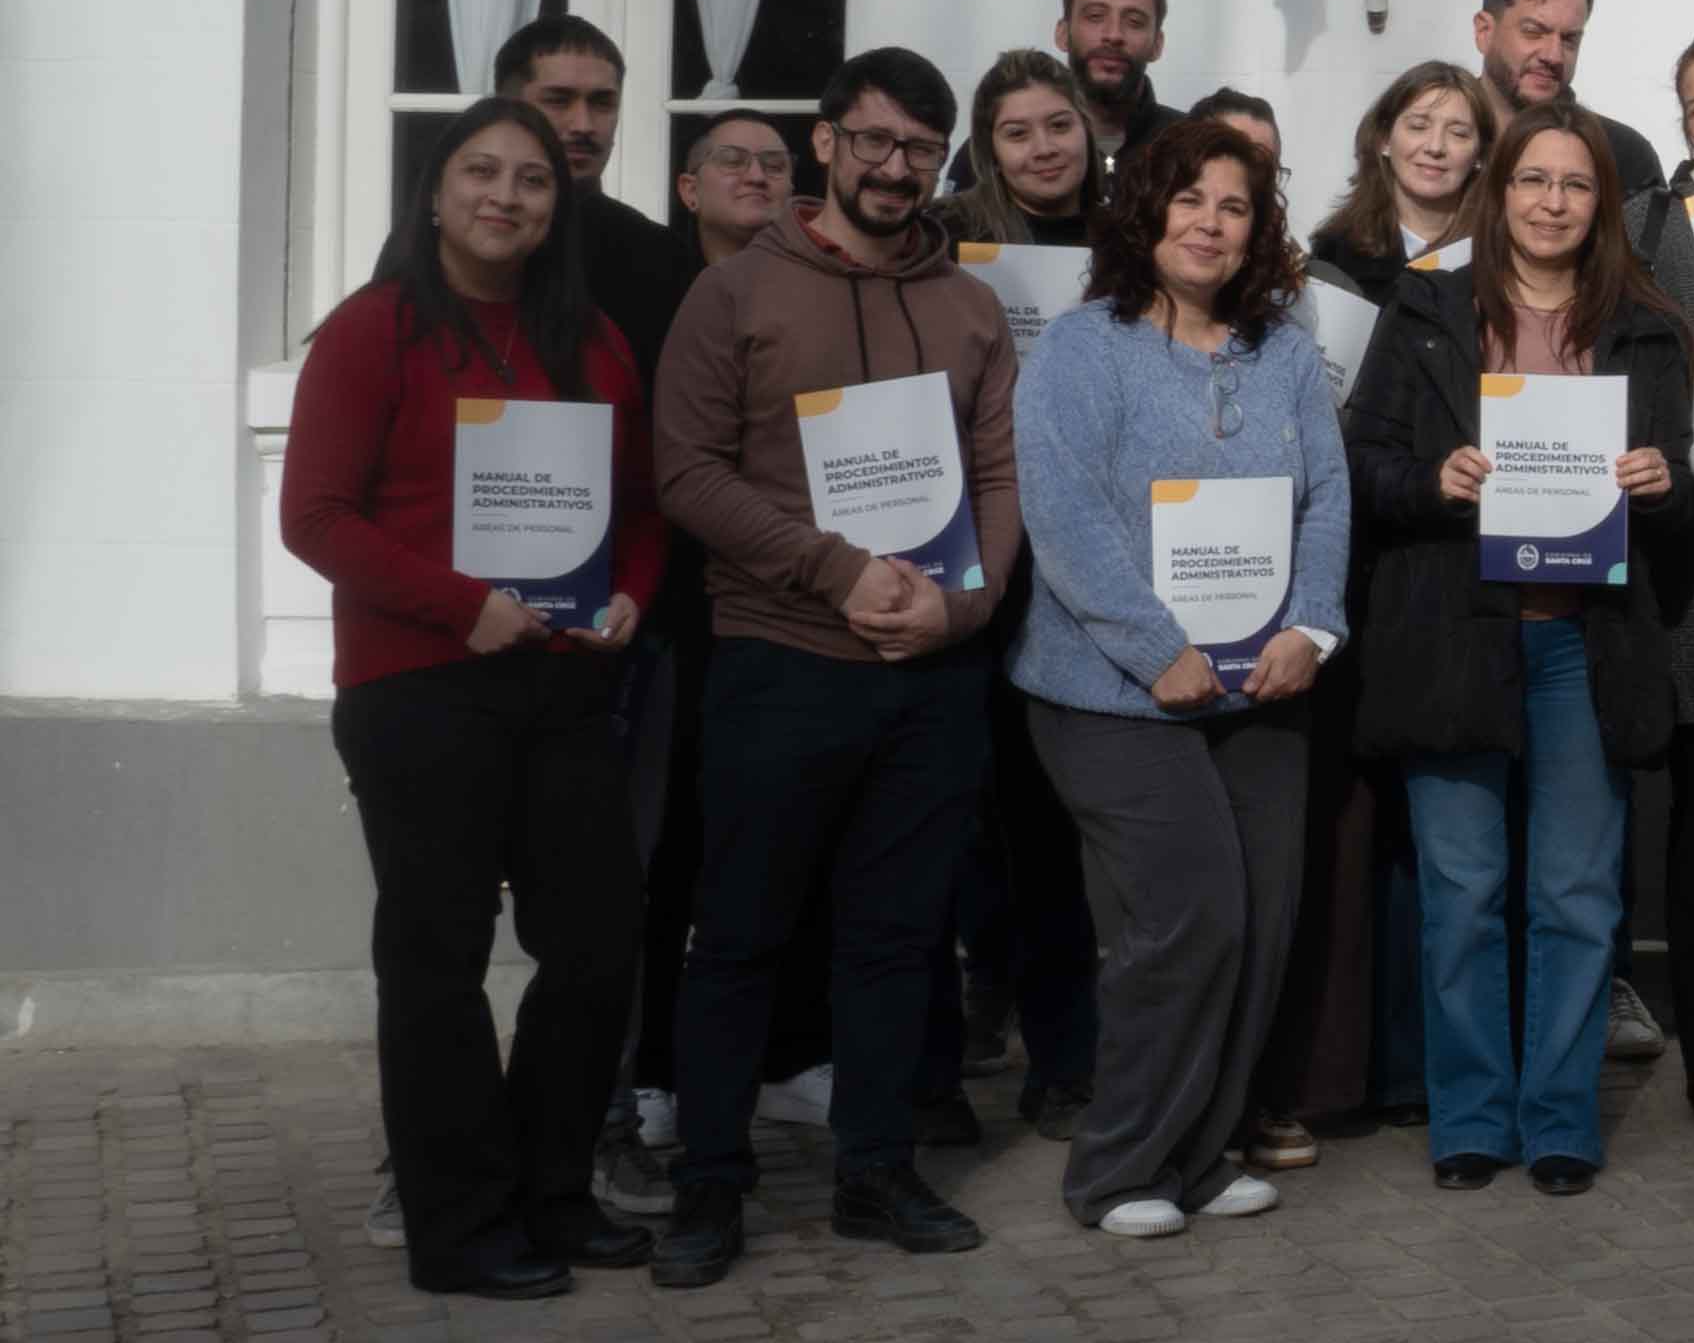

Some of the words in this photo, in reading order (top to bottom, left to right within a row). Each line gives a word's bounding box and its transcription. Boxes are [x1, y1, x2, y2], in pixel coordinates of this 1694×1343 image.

[1024, 307, 1038, 315] DE
[1496, 440, 1548, 451] MANUAL
[1552, 441, 1568, 451] DE
[823, 453, 879, 470] MANUAL
[882, 449, 899, 460] DE
[1496, 451, 1606, 463] PROCEDIMIENTOS
[825, 456, 941, 482] PROCEDIMIENTOS
[1496, 464, 1609, 475] ADMINISTRATIVOS
[473, 472, 530, 483] MANUAL
[535, 473, 552, 483] DE
[828, 468, 944, 495] ADMINISTRATIVOS
[472, 485, 591, 497] PROCEDIMIENTOS
[472, 499, 593, 510] ADMINISTRATIVOS
[1171, 546, 1221, 556] MANUAL
[1224, 545, 1240, 555] DE
[1171, 556, 1272, 568] PROCEDIMIENTOS
[1171, 568, 1275, 581] ADMINISTRATIVOS
